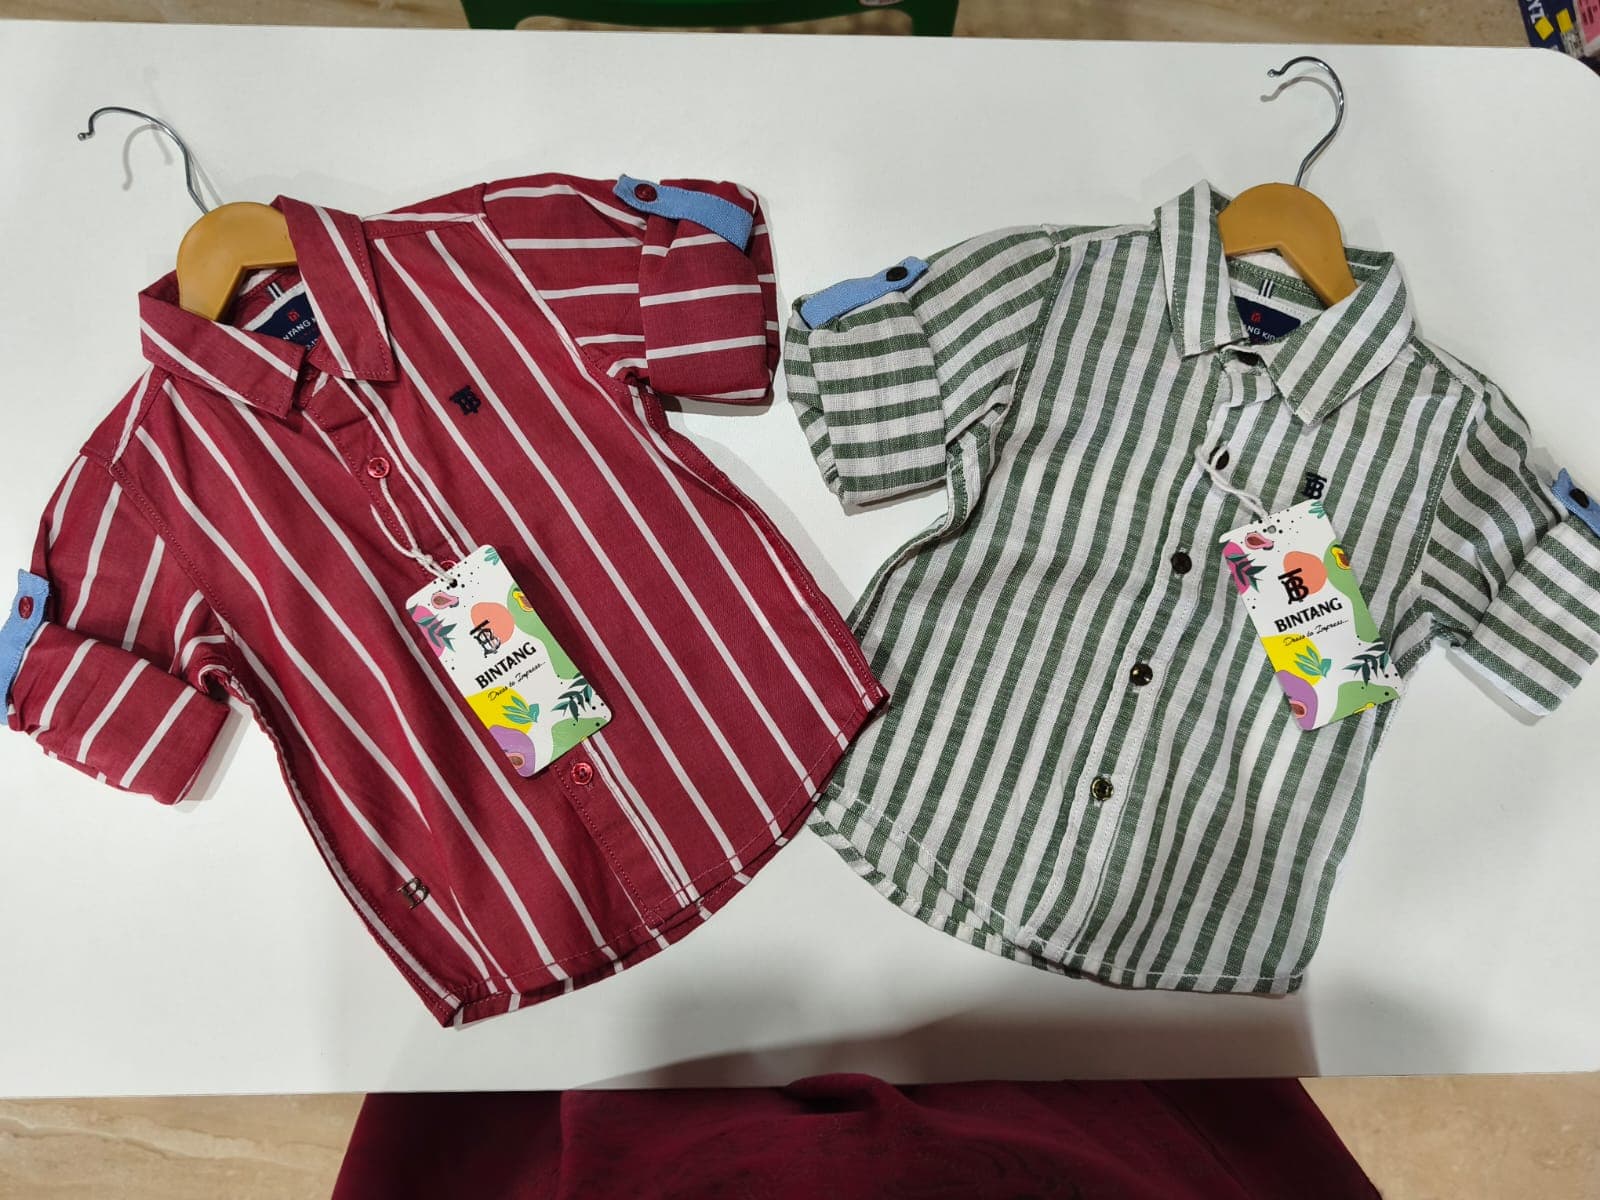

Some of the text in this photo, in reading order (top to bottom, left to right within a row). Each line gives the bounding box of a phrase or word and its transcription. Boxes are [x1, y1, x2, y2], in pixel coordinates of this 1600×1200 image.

[1274, 597, 1343, 633] BINTANG
[1283, 634, 1306, 647] Dress
[475, 641, 537, 689] BINTANG
[488, 685, 508, 701] Dress
